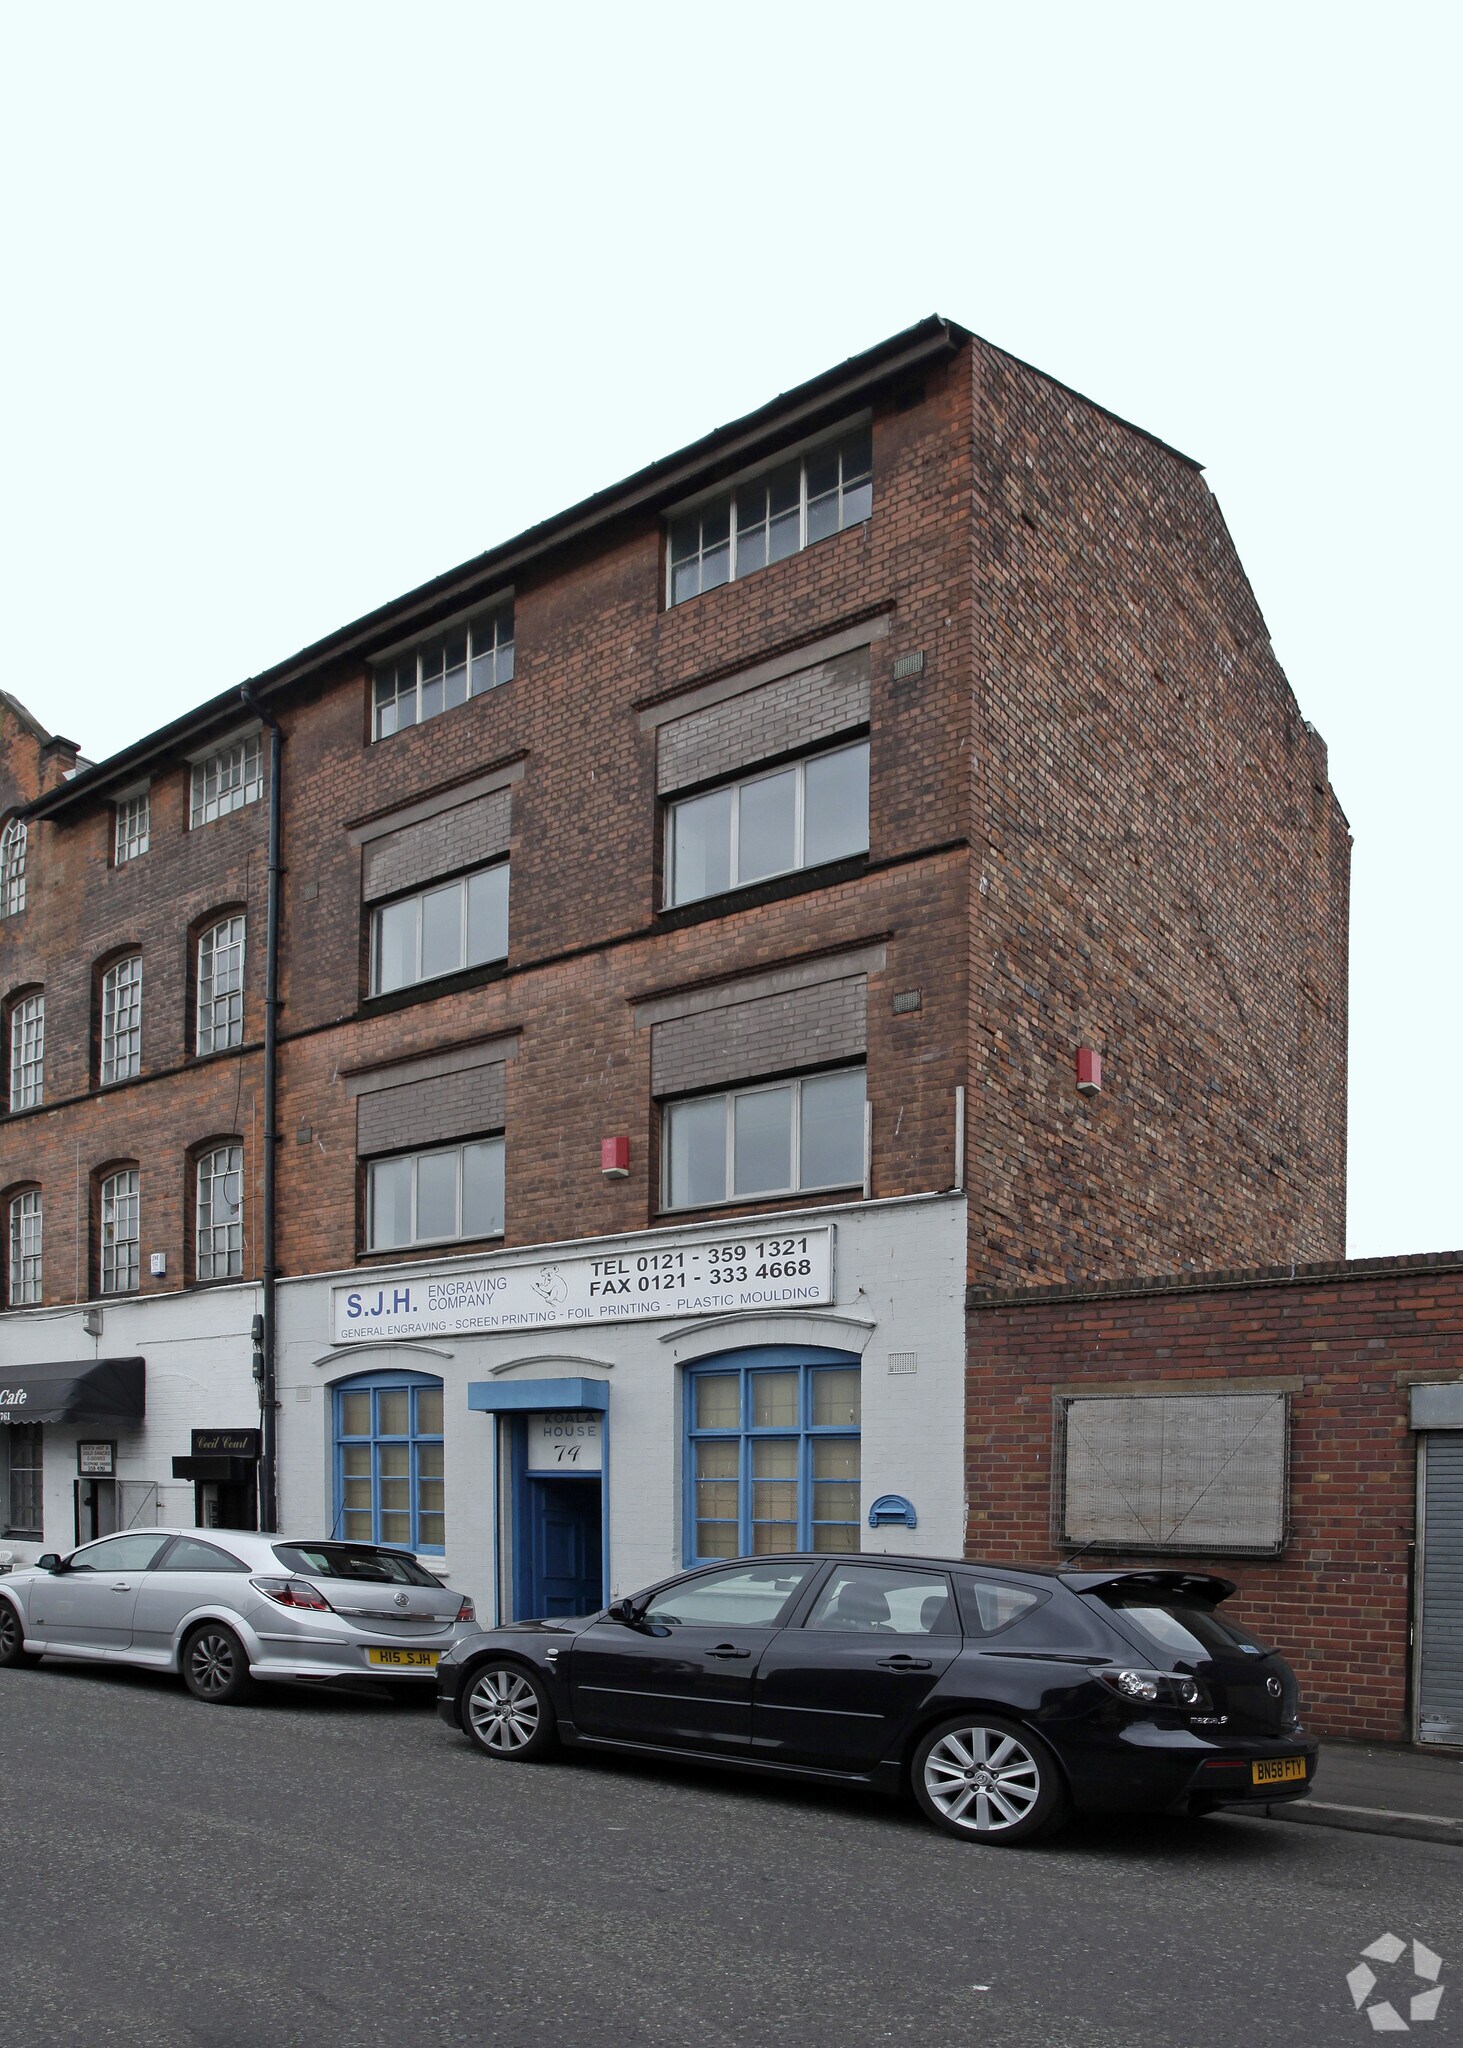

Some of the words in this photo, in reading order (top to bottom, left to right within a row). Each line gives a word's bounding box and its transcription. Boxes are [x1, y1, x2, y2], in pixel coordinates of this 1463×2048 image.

[591, 1260, 630, 1277] TEL
[636, 1252, 685, 1272] 0121
[708, 1245, 747, 1264] 359
[755, 1237, 808, 1258] 1321
[428, 1276, 507, 1298] ENGRAVING
[590, 1278, 631, 1296] FAX
[638, 1273, 686, 1292] 0121
[709, 1265, 748, 1285] 333
[755, 1259, 812, 1280] 4668
[346, 1288, 418, 1319] S.J.H.
[428, 1292, 495, 1311] COMPANY
[341, 1326, 385, 1339] GENERAL
[387, 1321, 447, 1334] ENGRAVING
[455, 1316, 499, 1329] SCREEN
[502, 1310, 556, 1325] PRINTING
[567, 1307, 594, 1319] FOIL
[600, 1301, 660, 1317] PRINTING
[677, 1294, 734, 1310] PLASTIC
[740, 1286, 820, 1304] MOULDING
[0, 1388, 28, 1405] Cafe
[545, 1413, 596, 1424] KOALA
[543, 1426, 597, 1437] HOUSE
[197, 1435, 220, 1449] Cecil
[222, 1435, 249, 1449] Court
[553, 1444, 582, 1462] 74
[380, 1651, 401, 1663] H15
[407, 1653, 431, 1665] SJH
[1258, 1761, 1283, 1781] BN58
[1285, 1758, 1302, 1777] FTY
